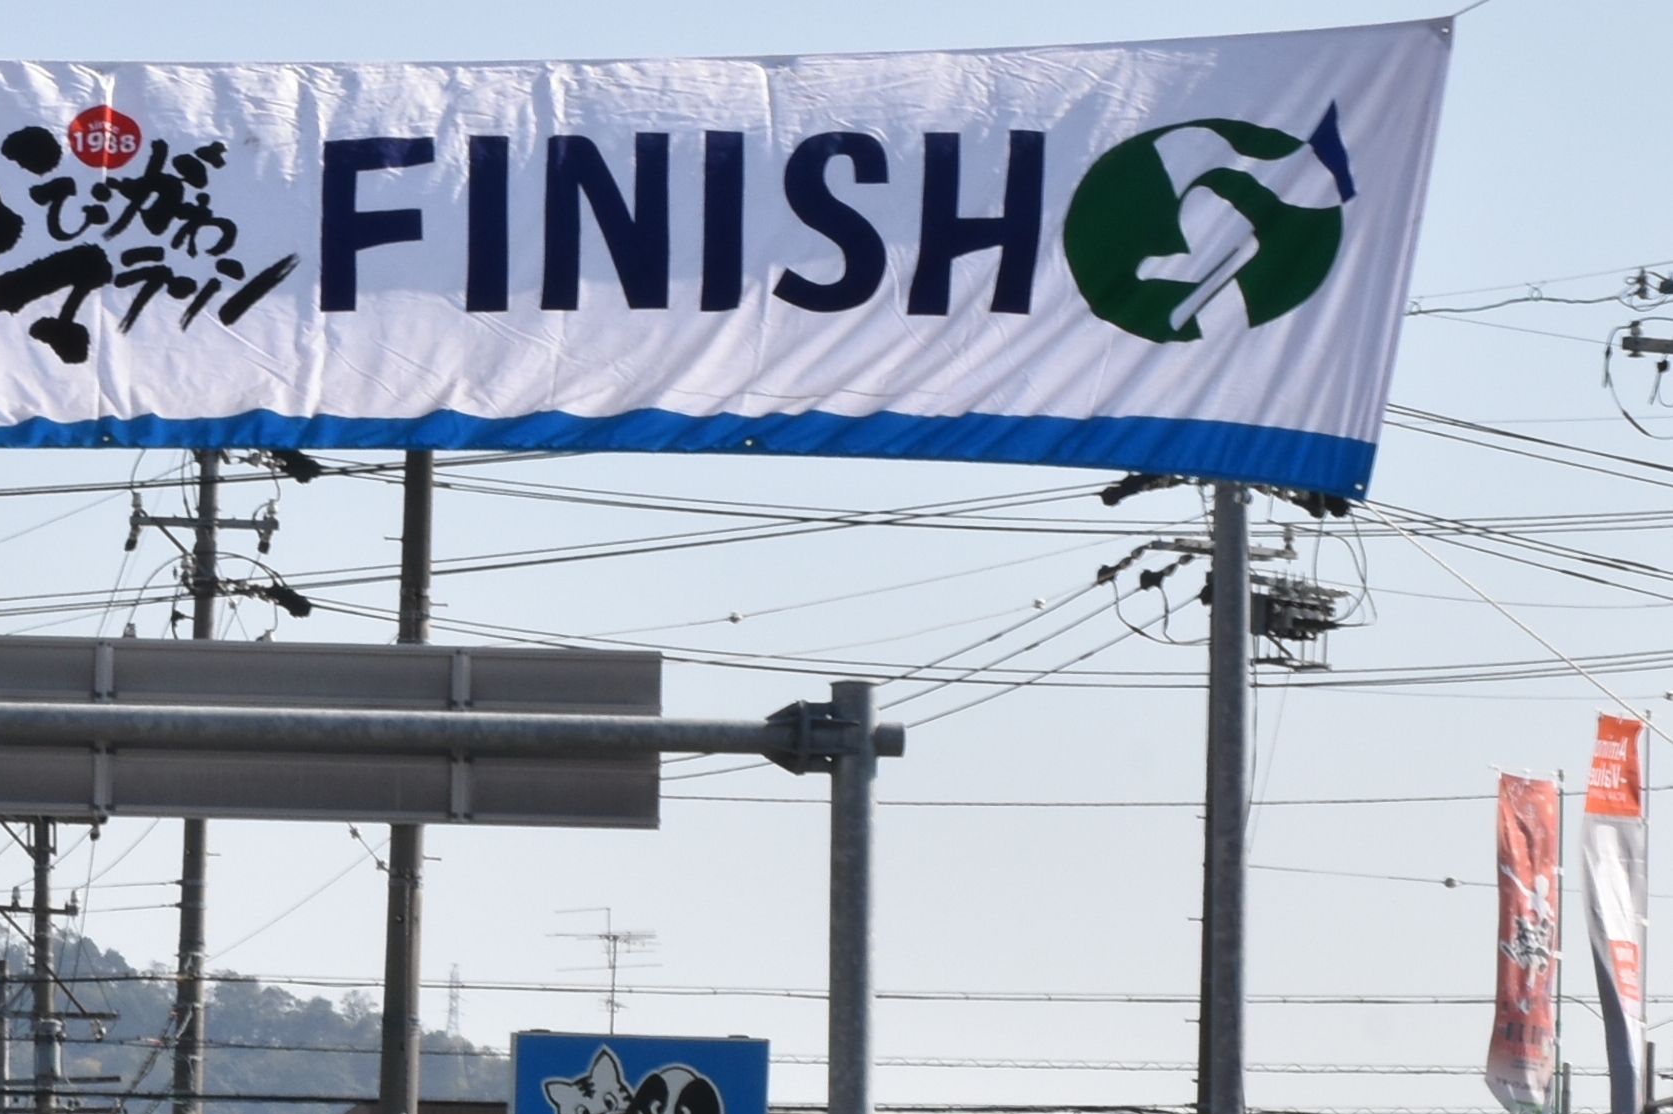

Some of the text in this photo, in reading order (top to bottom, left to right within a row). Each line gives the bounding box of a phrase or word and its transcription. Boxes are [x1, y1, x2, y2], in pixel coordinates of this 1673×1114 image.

[88, 121, 120, 135] since
[73, 130, 136, 154] 1988
[320, 130, 1046, 316] FINISH
